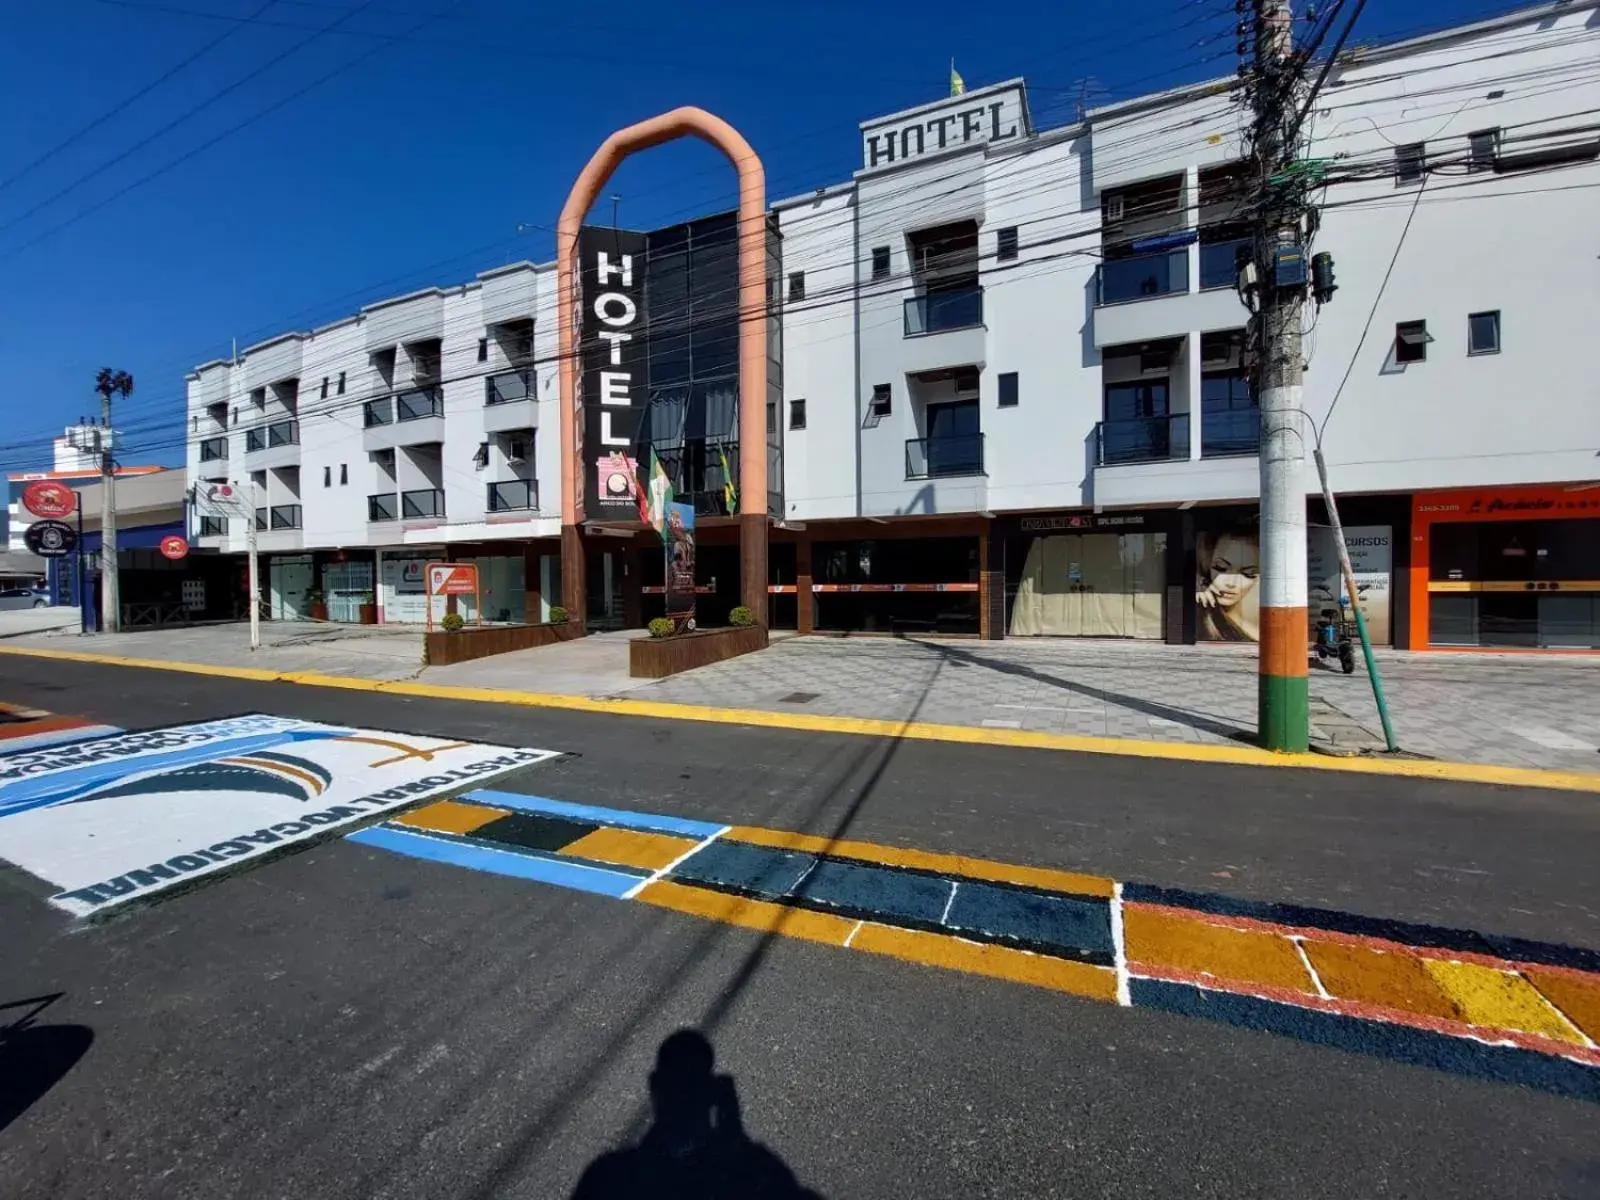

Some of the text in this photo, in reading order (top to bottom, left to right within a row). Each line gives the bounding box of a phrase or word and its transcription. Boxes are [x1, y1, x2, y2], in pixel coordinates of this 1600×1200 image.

[867, 101, 1016, 167] HOTEL
[594, 251, 637, 445] HOTEL
[1344, 536, 1389, 546] CURSOS
[53, 751, 543, 905] PASTORAL VOCACIONAL
